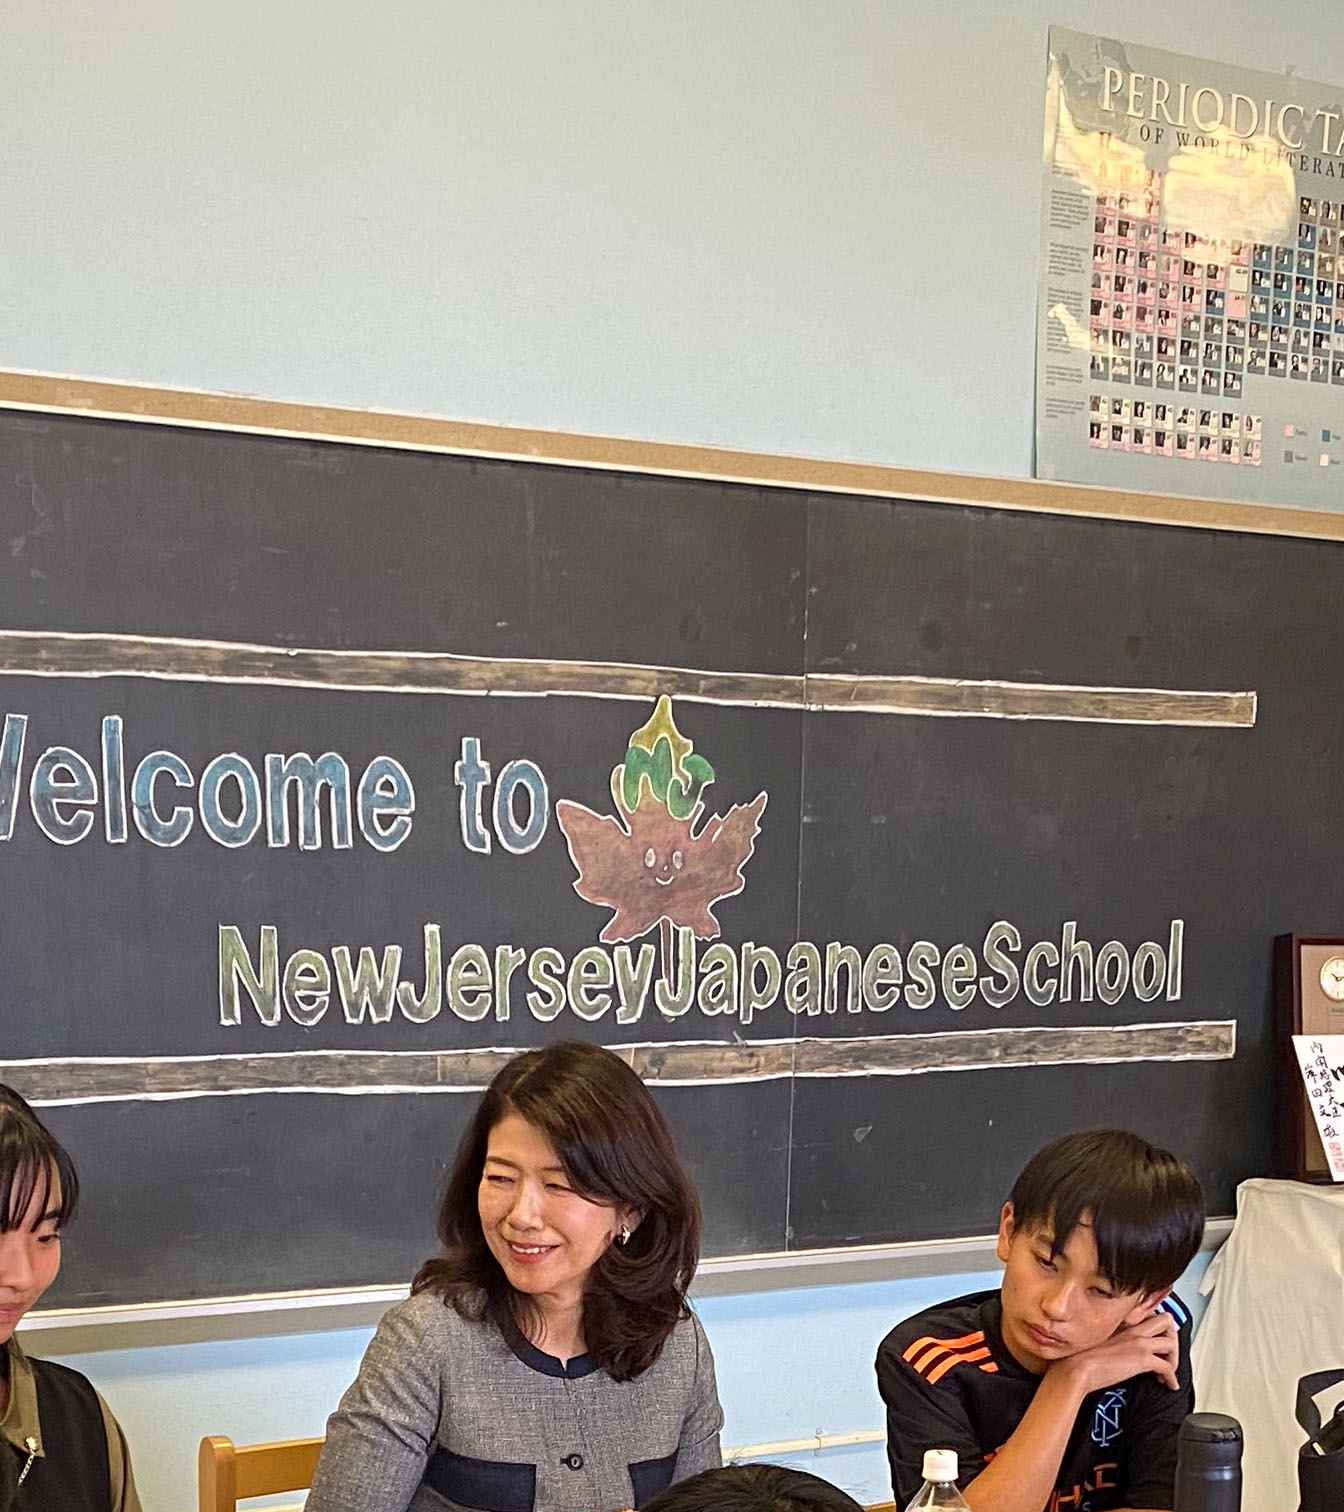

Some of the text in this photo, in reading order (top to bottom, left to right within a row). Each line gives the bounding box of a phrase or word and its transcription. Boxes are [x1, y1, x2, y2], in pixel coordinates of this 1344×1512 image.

[1100, 65, 1306, 150] PERIODIC
[1139, 123, 1165, 145] OF
[455, 736, 550, 856] to
